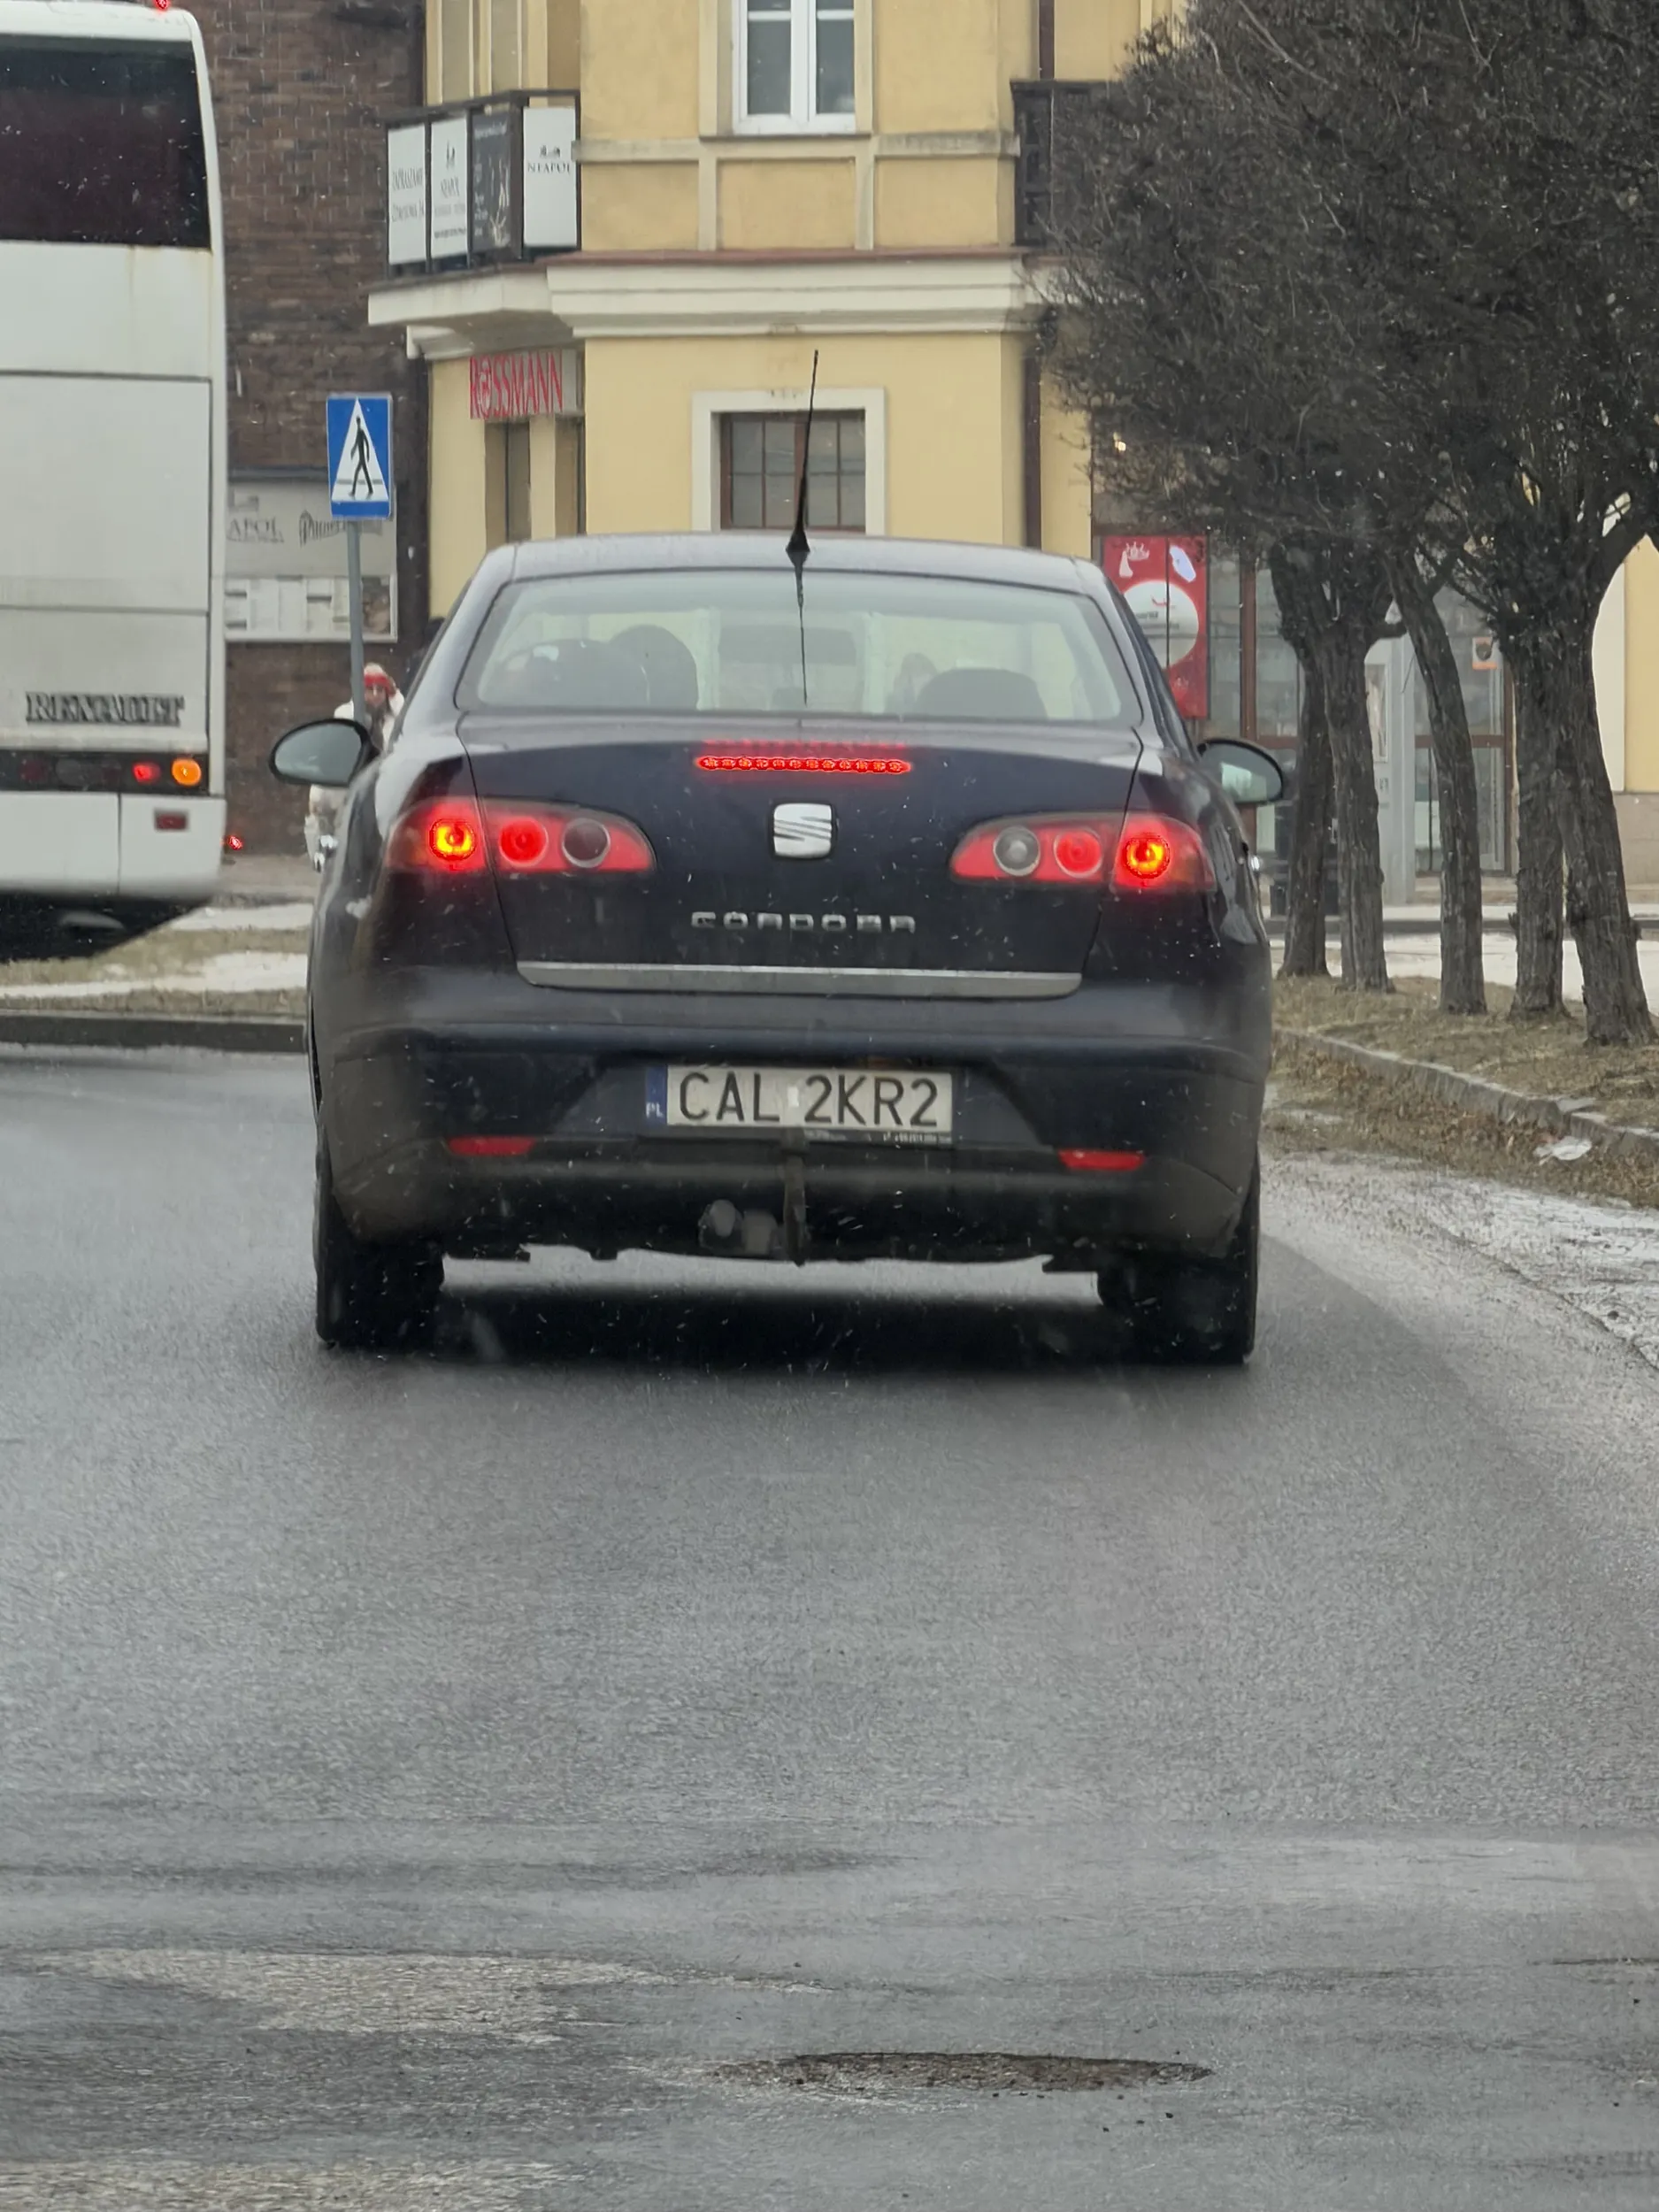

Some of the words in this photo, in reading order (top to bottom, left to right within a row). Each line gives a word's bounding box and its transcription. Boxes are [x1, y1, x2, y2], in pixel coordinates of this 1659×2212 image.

[469, 352, 563, 419] ROSSMANN
[646, 1102, 664, 1118] PL
[680, 1071, 780, 1122] CAL
[804, 1074, 939, 1127] 2KR2
